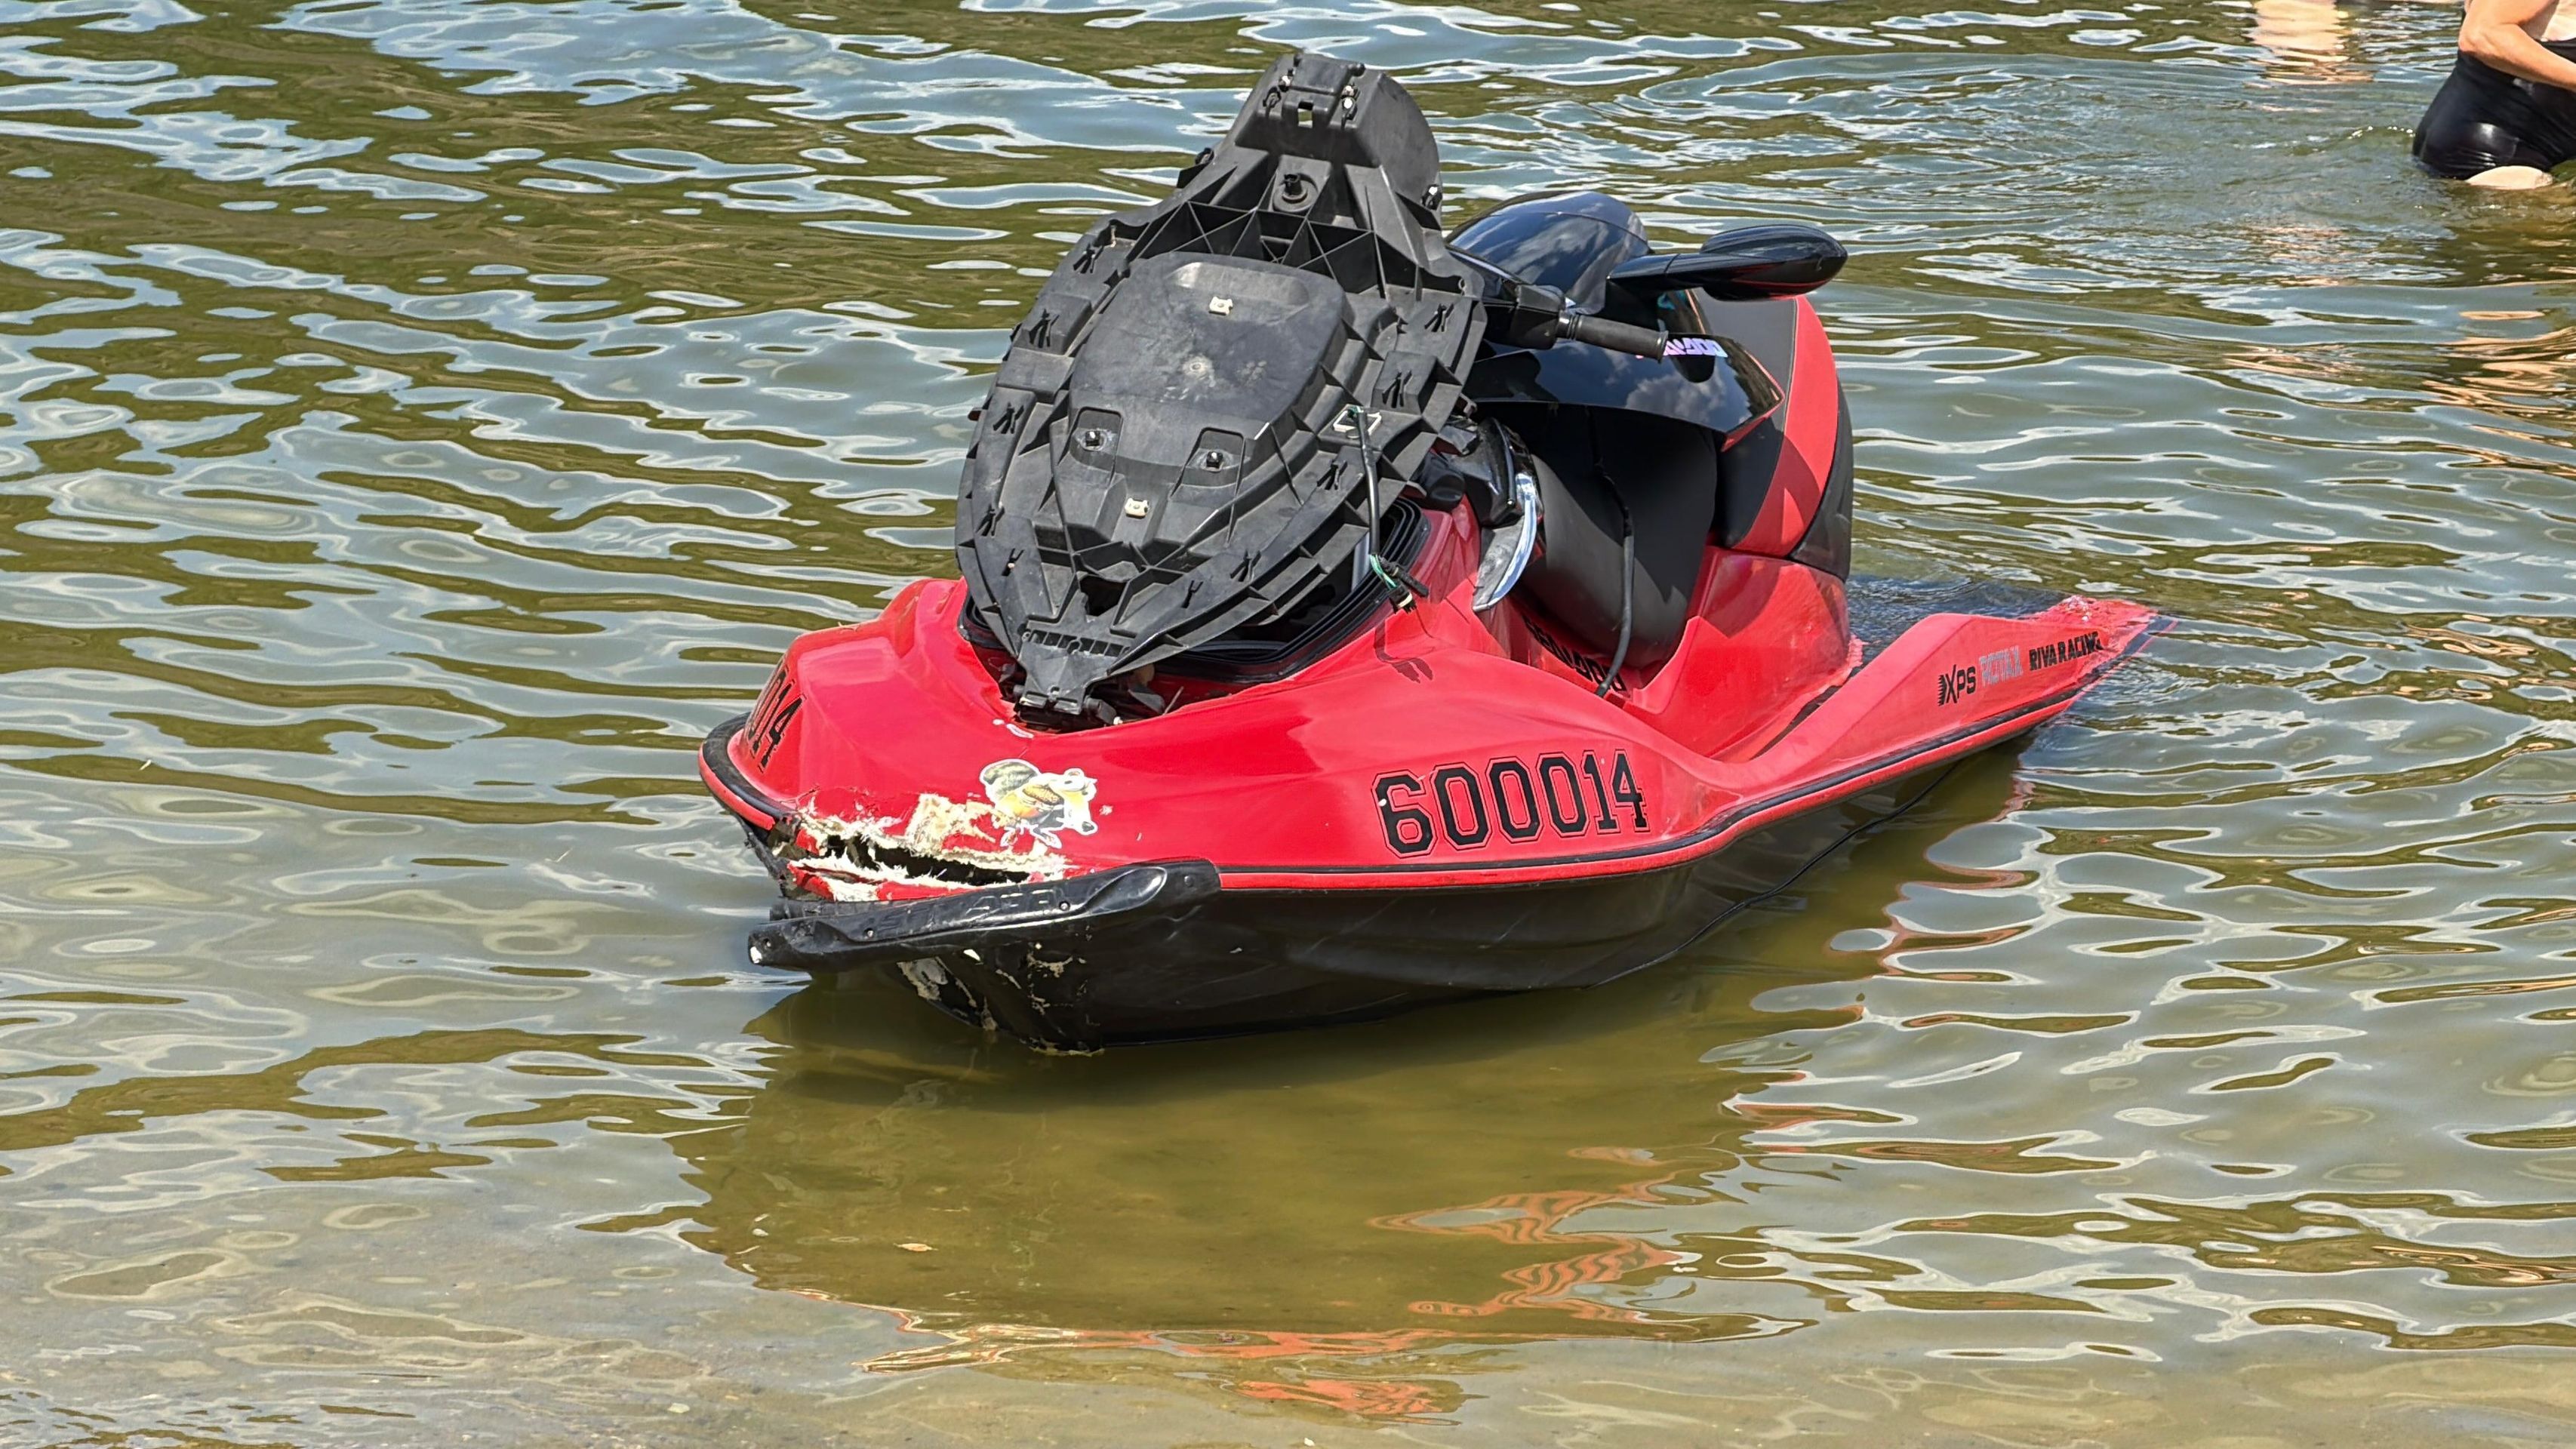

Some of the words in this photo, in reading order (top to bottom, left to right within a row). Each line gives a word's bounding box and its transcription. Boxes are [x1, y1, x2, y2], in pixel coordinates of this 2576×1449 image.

[2028, 644, 2058, 671] RIVA
[2057, 630, 2104, 663] RACING
[1371, 749, 1651, 859] 600014
